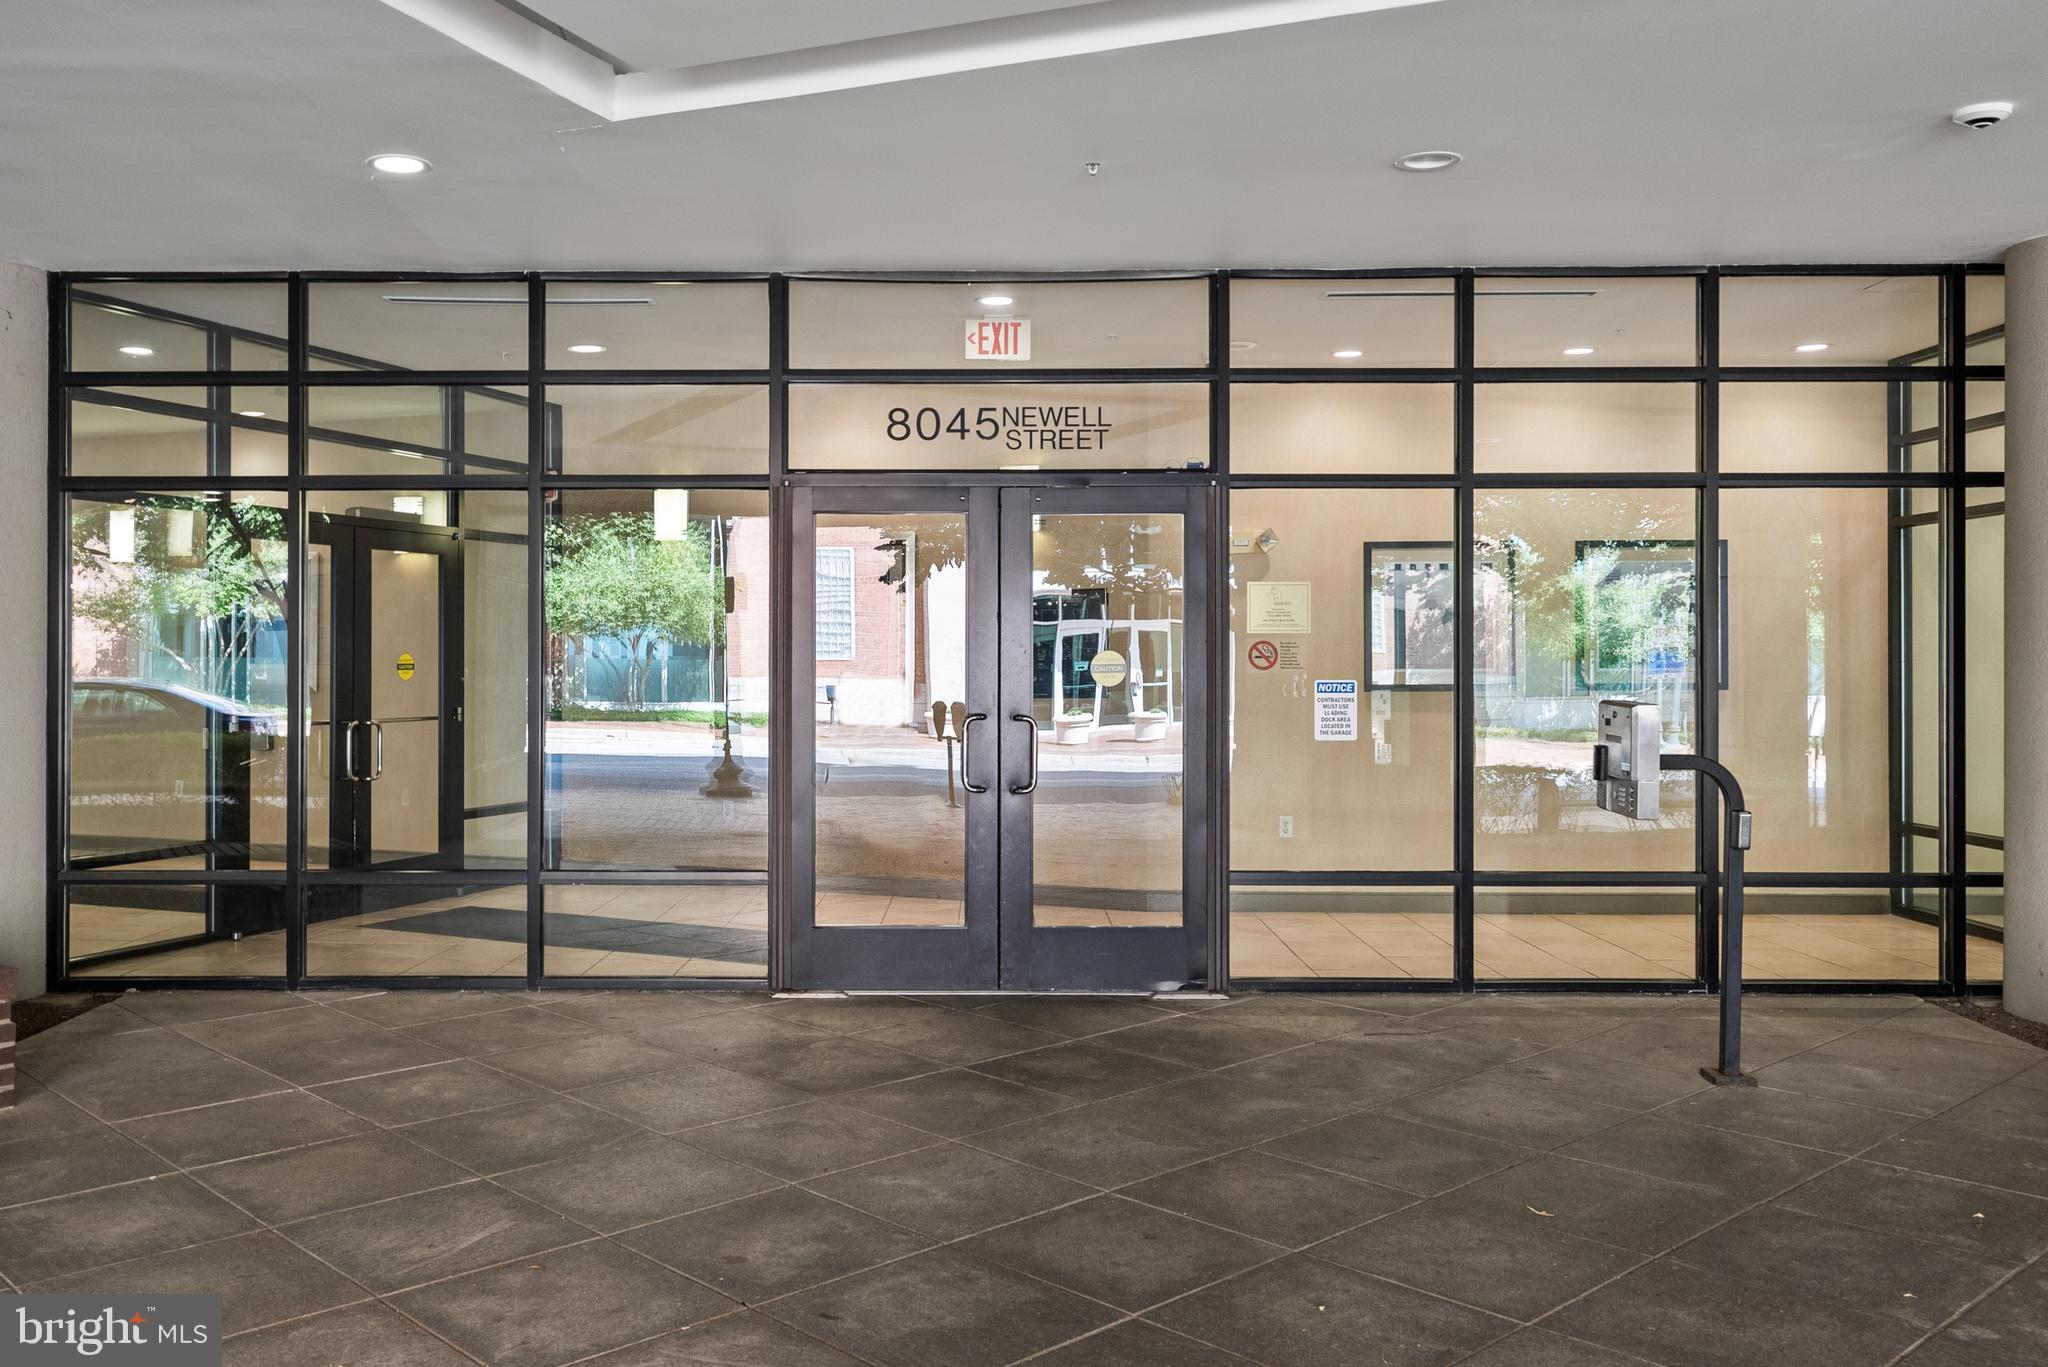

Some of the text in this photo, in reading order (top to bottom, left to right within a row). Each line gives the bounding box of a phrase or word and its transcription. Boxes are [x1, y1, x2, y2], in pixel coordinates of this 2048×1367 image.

[977, 321, 1022, 355] EXIT
[886, 407, 1000, 441] 8045
[1002, 406, 1112, 427] NEWELL
[1005, 429, 1109, 450] STREET
[1094, 664, 1124, 673] CAUTION
[1318, 683, 1354, 692] NOTICE
